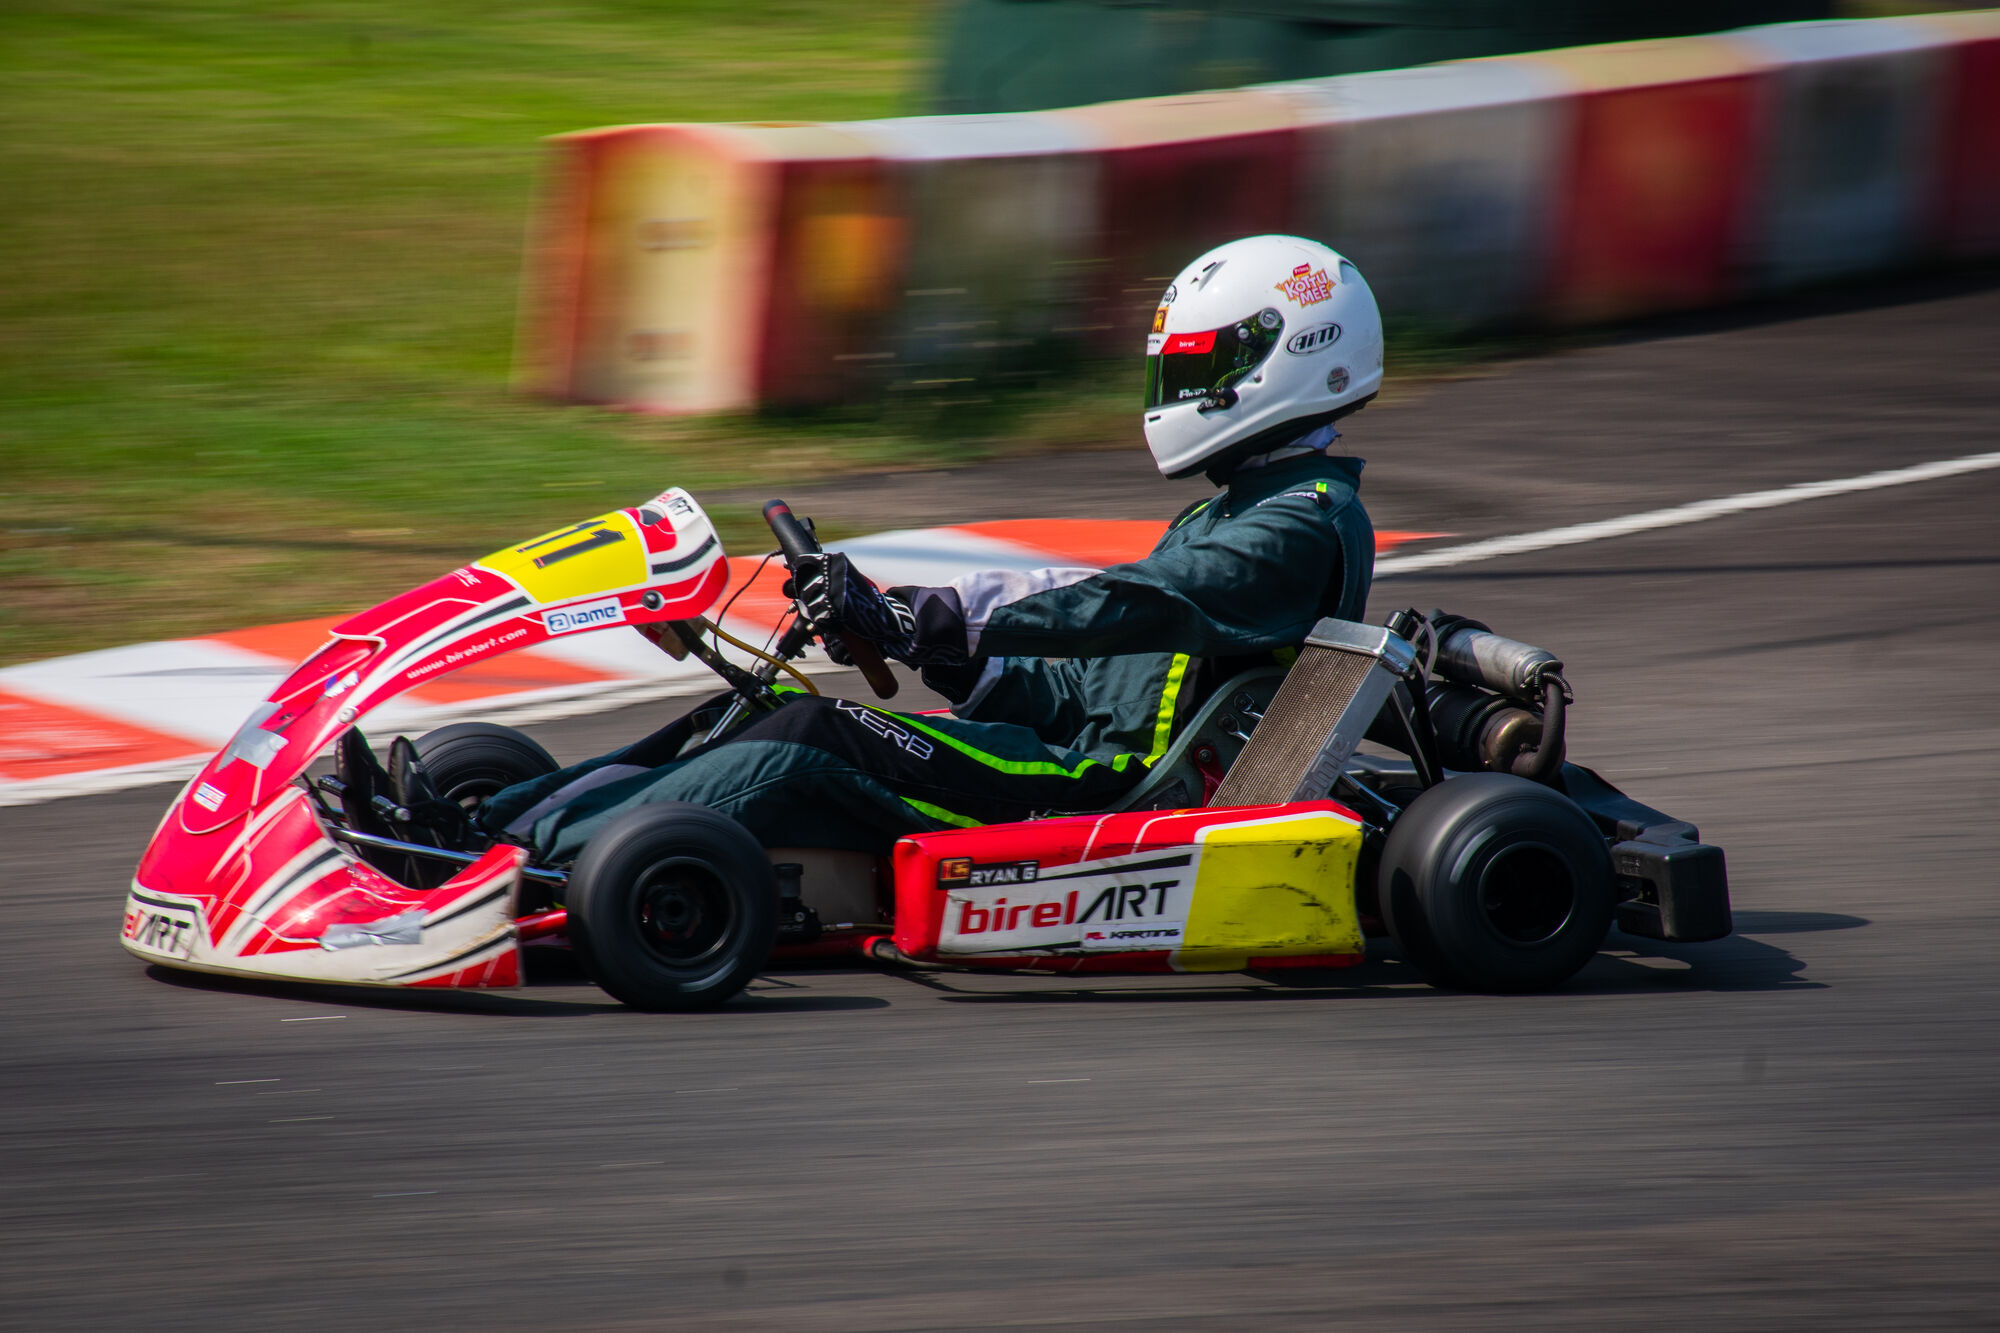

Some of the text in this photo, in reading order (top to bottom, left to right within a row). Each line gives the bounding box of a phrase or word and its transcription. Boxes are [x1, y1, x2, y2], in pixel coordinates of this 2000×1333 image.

[1283, 270, 1328, 299] KOTTU
[1299, 284, 1328, 304] MEE
[516, 520, 625, 569] 11
[835, 698, 934, 761] KERB
[959, 880, 1179, 934] birelART
[1109, 928, 1180, 939] KARTING
